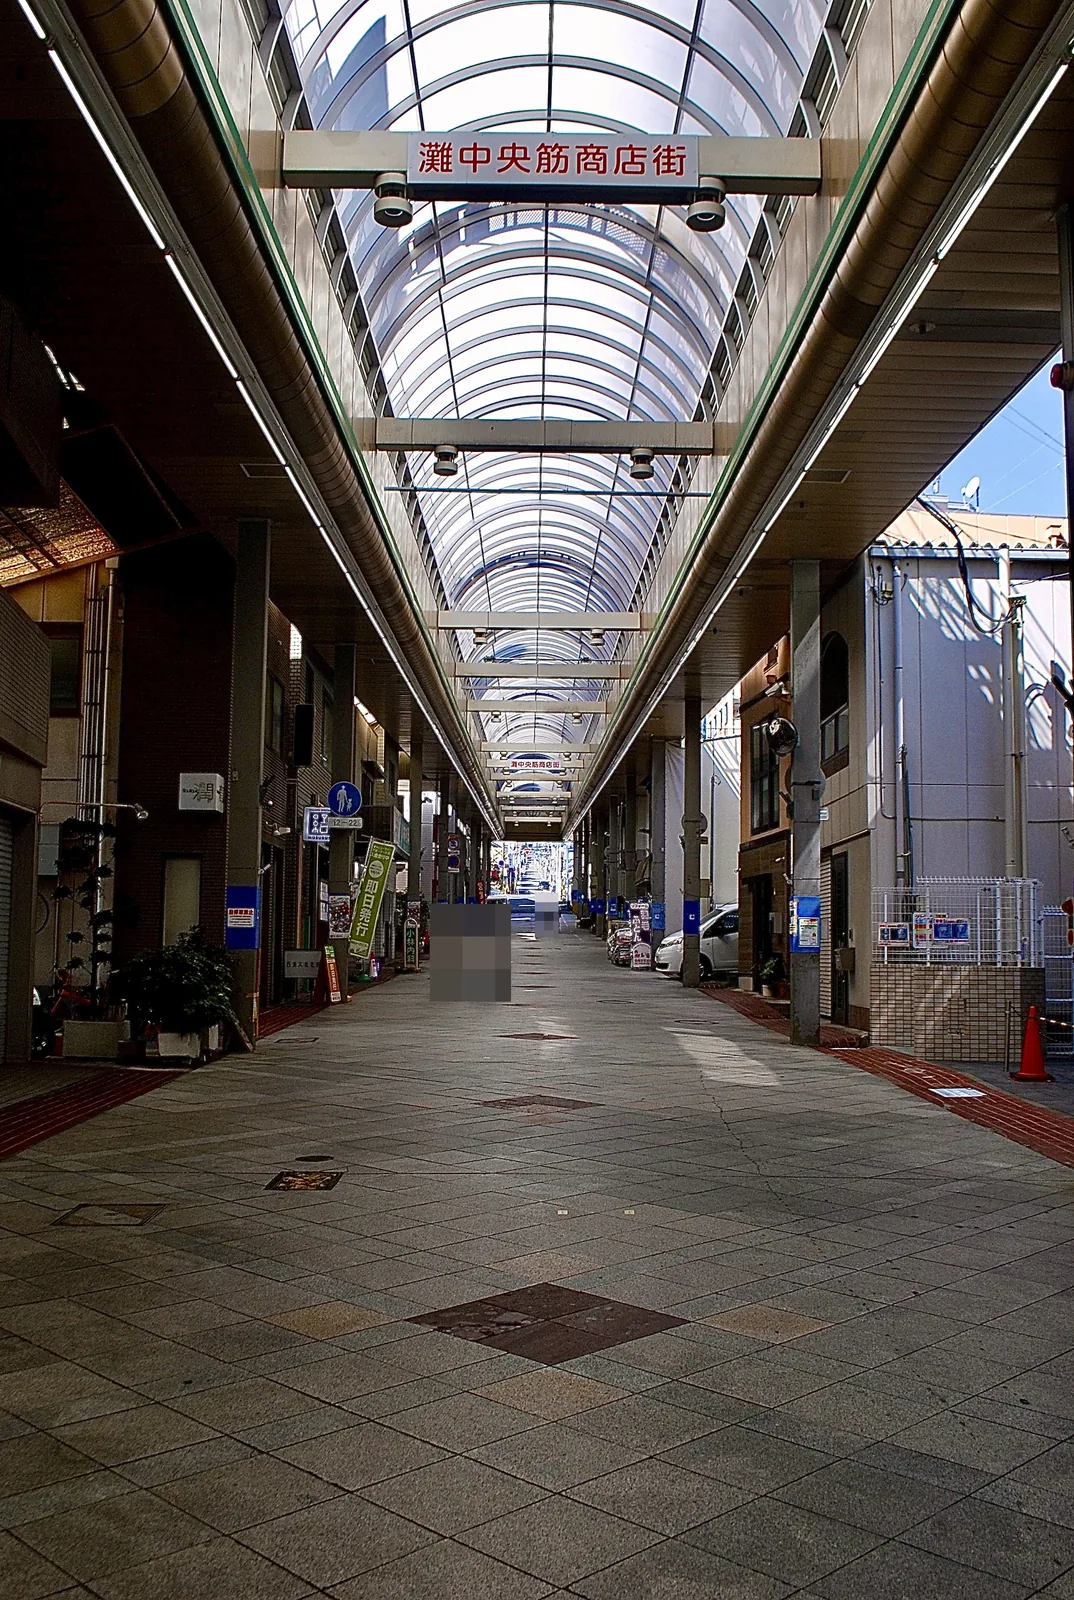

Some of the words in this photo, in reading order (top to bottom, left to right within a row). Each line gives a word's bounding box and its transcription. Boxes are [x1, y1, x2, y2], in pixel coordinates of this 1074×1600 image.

[418, 142, 687, 177] 灘中央筋商店街
[356, 879, 379, 937] 即日発行
[632, 915, 642, 942] ふとん
